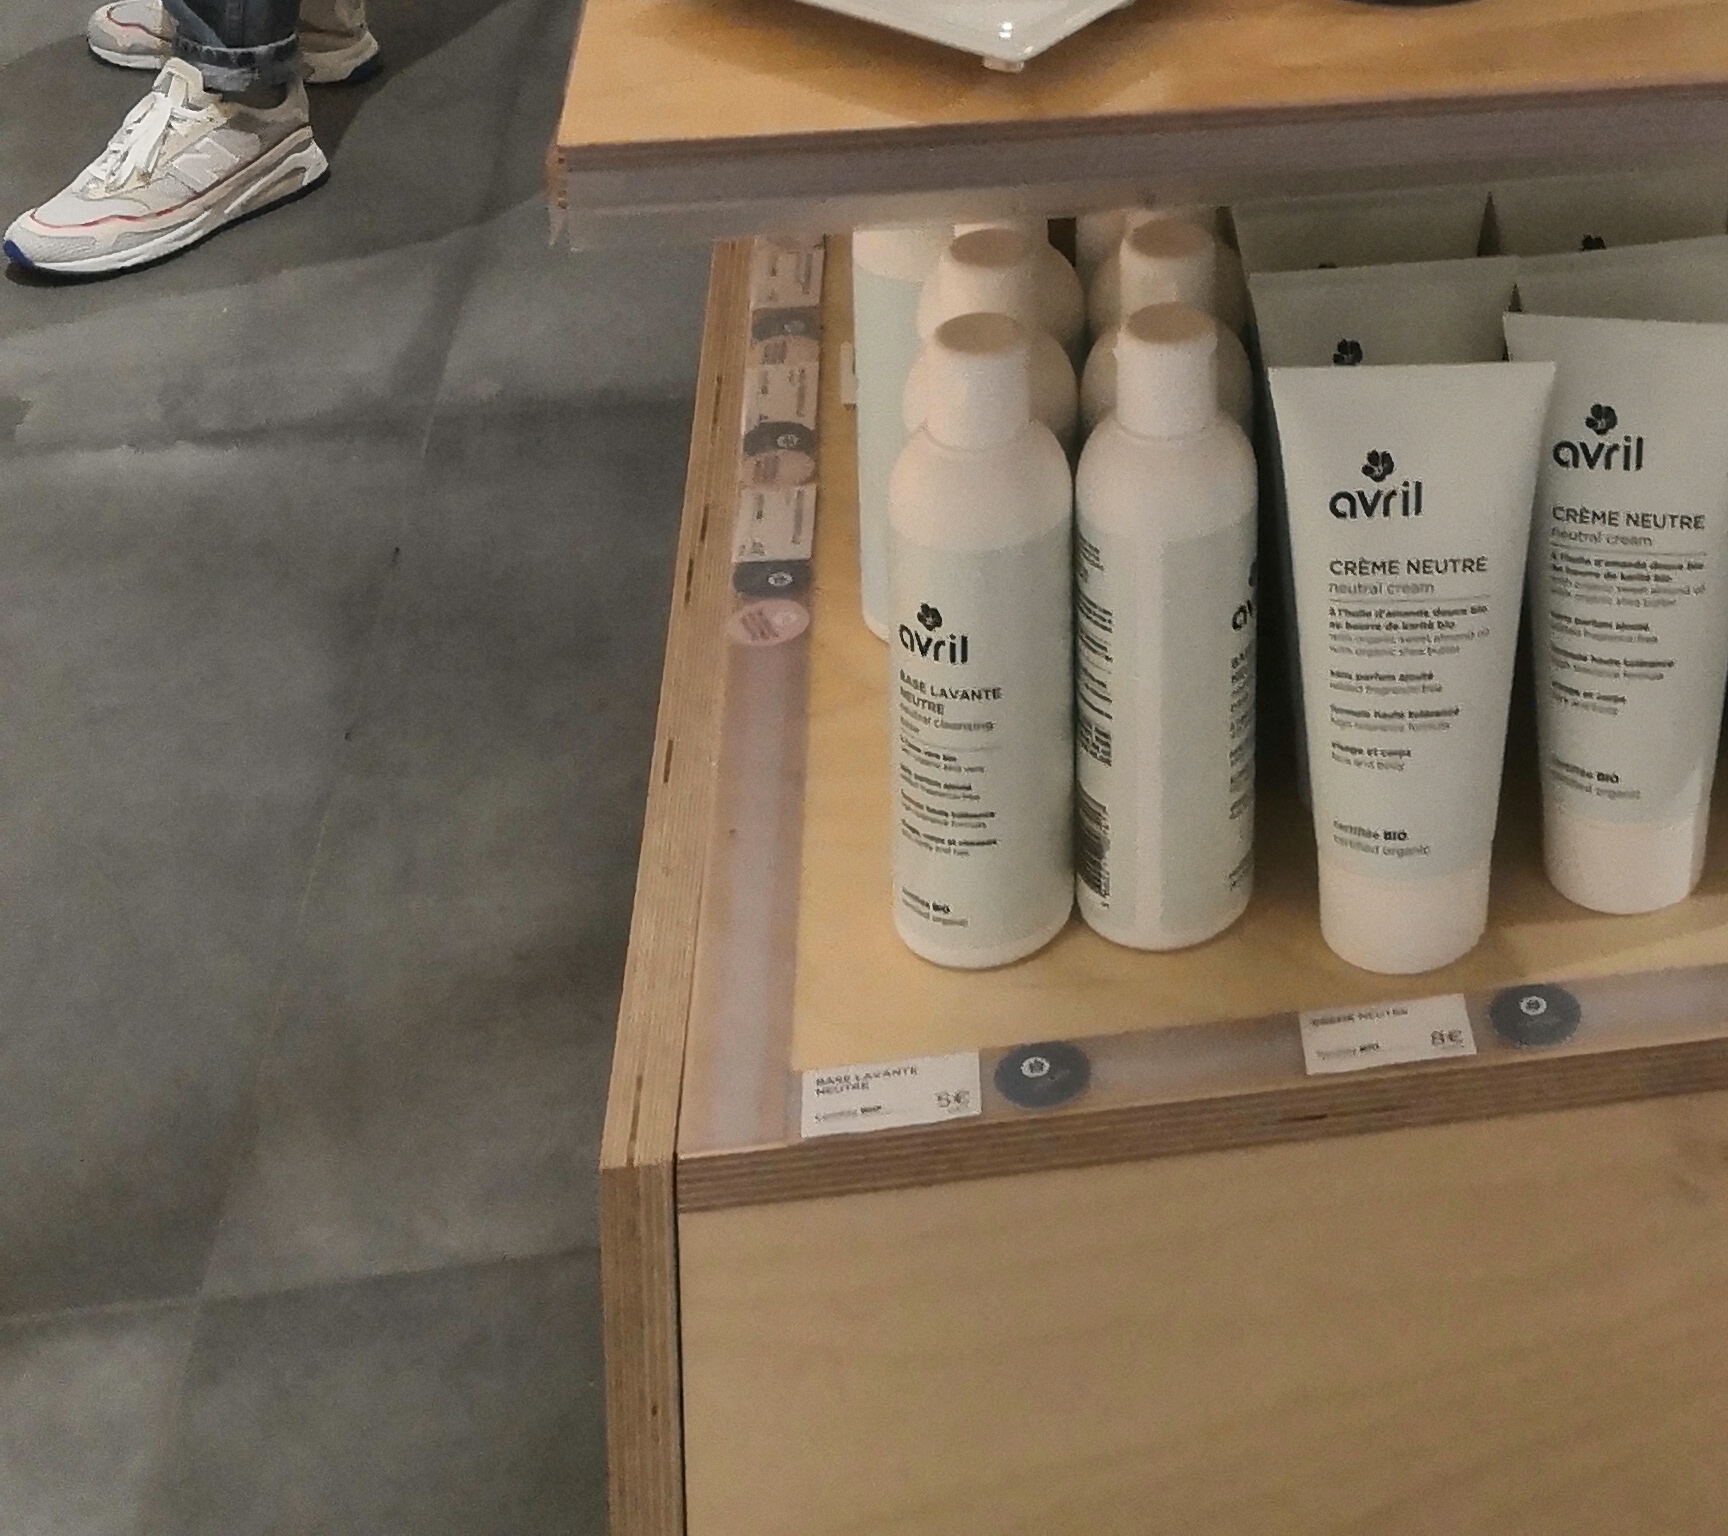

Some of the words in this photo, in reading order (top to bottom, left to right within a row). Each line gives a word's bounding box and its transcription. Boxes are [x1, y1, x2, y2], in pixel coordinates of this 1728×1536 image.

[1552, 434, 1644, 471] avril
[1328, 479, 1423, 520] avril
[1552, 504, 1620, 527] CRÈME
[1625, 511, 1706, 530] NEUTRE
[1328, 557, 1400, 577] CRÈME
[1405, 555, 1489, 575] NEUTRE
[1328, 581, 1383, 596] neutral
[1386, 582, 1436, 596] cream
[898, 624, 969, 665] avril
[929, 686, 1003, 702] LAVANTE
[1383, 829, 1408, 842] BIO
